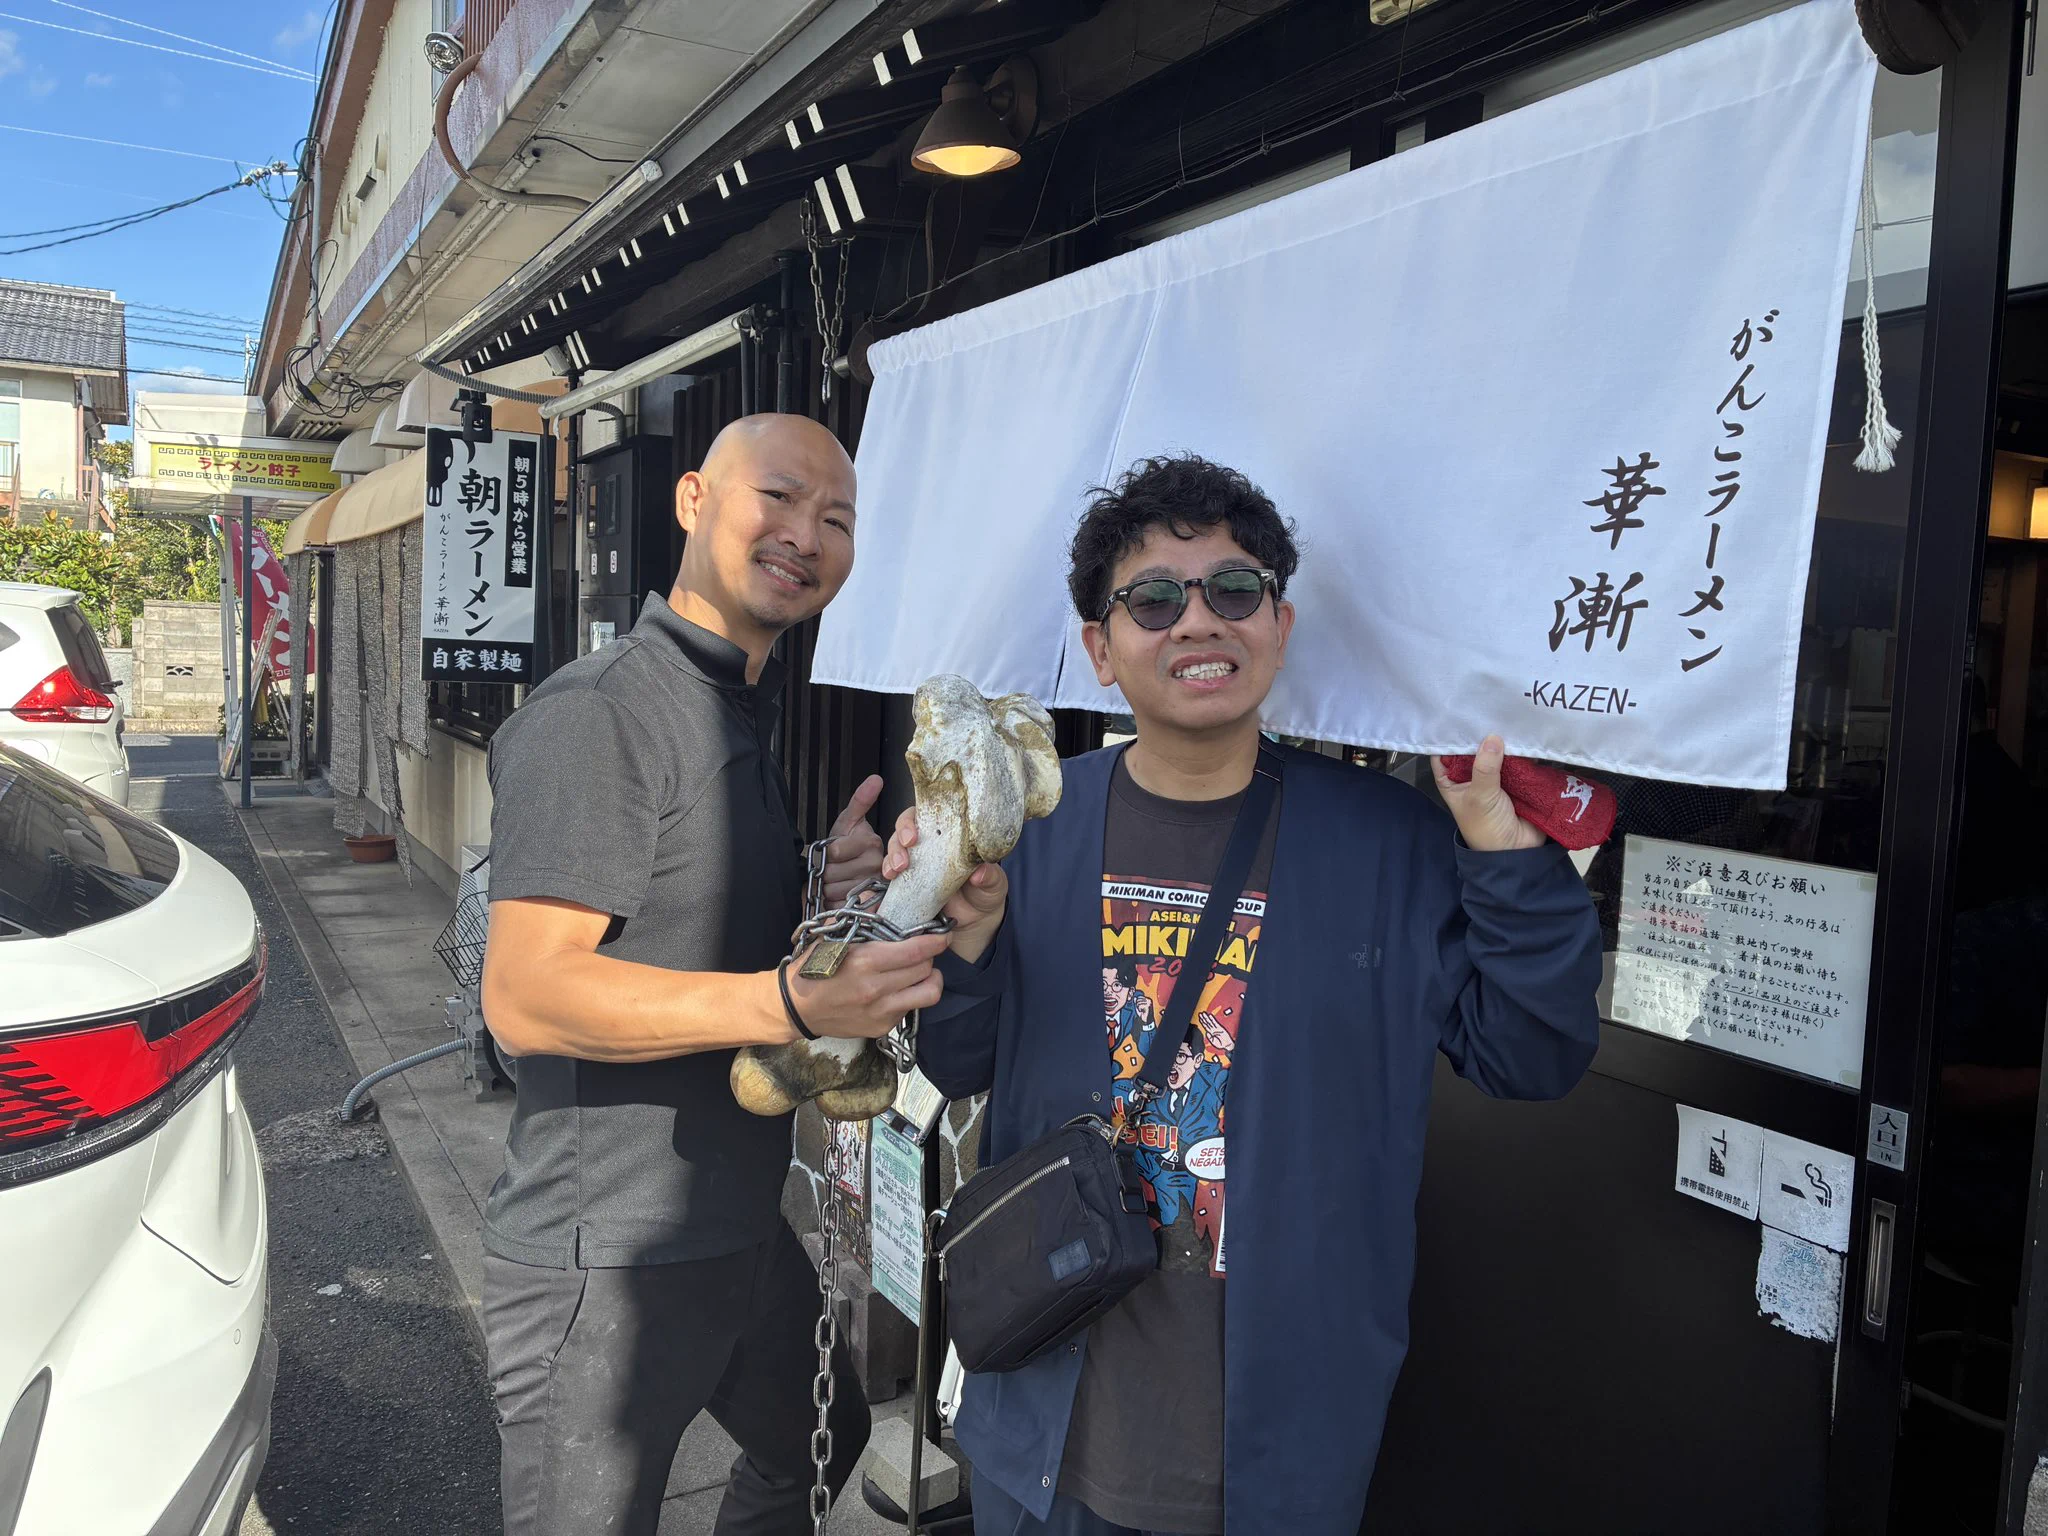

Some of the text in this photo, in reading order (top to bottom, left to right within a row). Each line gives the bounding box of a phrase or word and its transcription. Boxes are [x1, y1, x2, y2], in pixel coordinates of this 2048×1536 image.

[198, 456, 301, 478] ラーメン・餃子
[1678, 308, 1781, 673] がんこラーメン
[510, 456, 530, 575] 朝5時から営業
[438, 512, 451, 592] がんこラーメン
[457, 467, 502, 638] 朝ラーメン
[1548, 451, 1667, 653] 華漸
[431, 646, 523, 673] 自家製麺
[1523, 679, 1638, 715] -KAZEN-
[1108, 885, 1165, 900] MIKIMAN
[1666, 855, 1826, 894] ※ご注意及びお願い
[1101, 925, 1257, 972] MIKIA
[1876, 1112, 1899, 1147] 入口
[1880, 1152, 1892, 1162] IN
[1680, 1175, 1750, 1212] 携帯電話使用禁止
